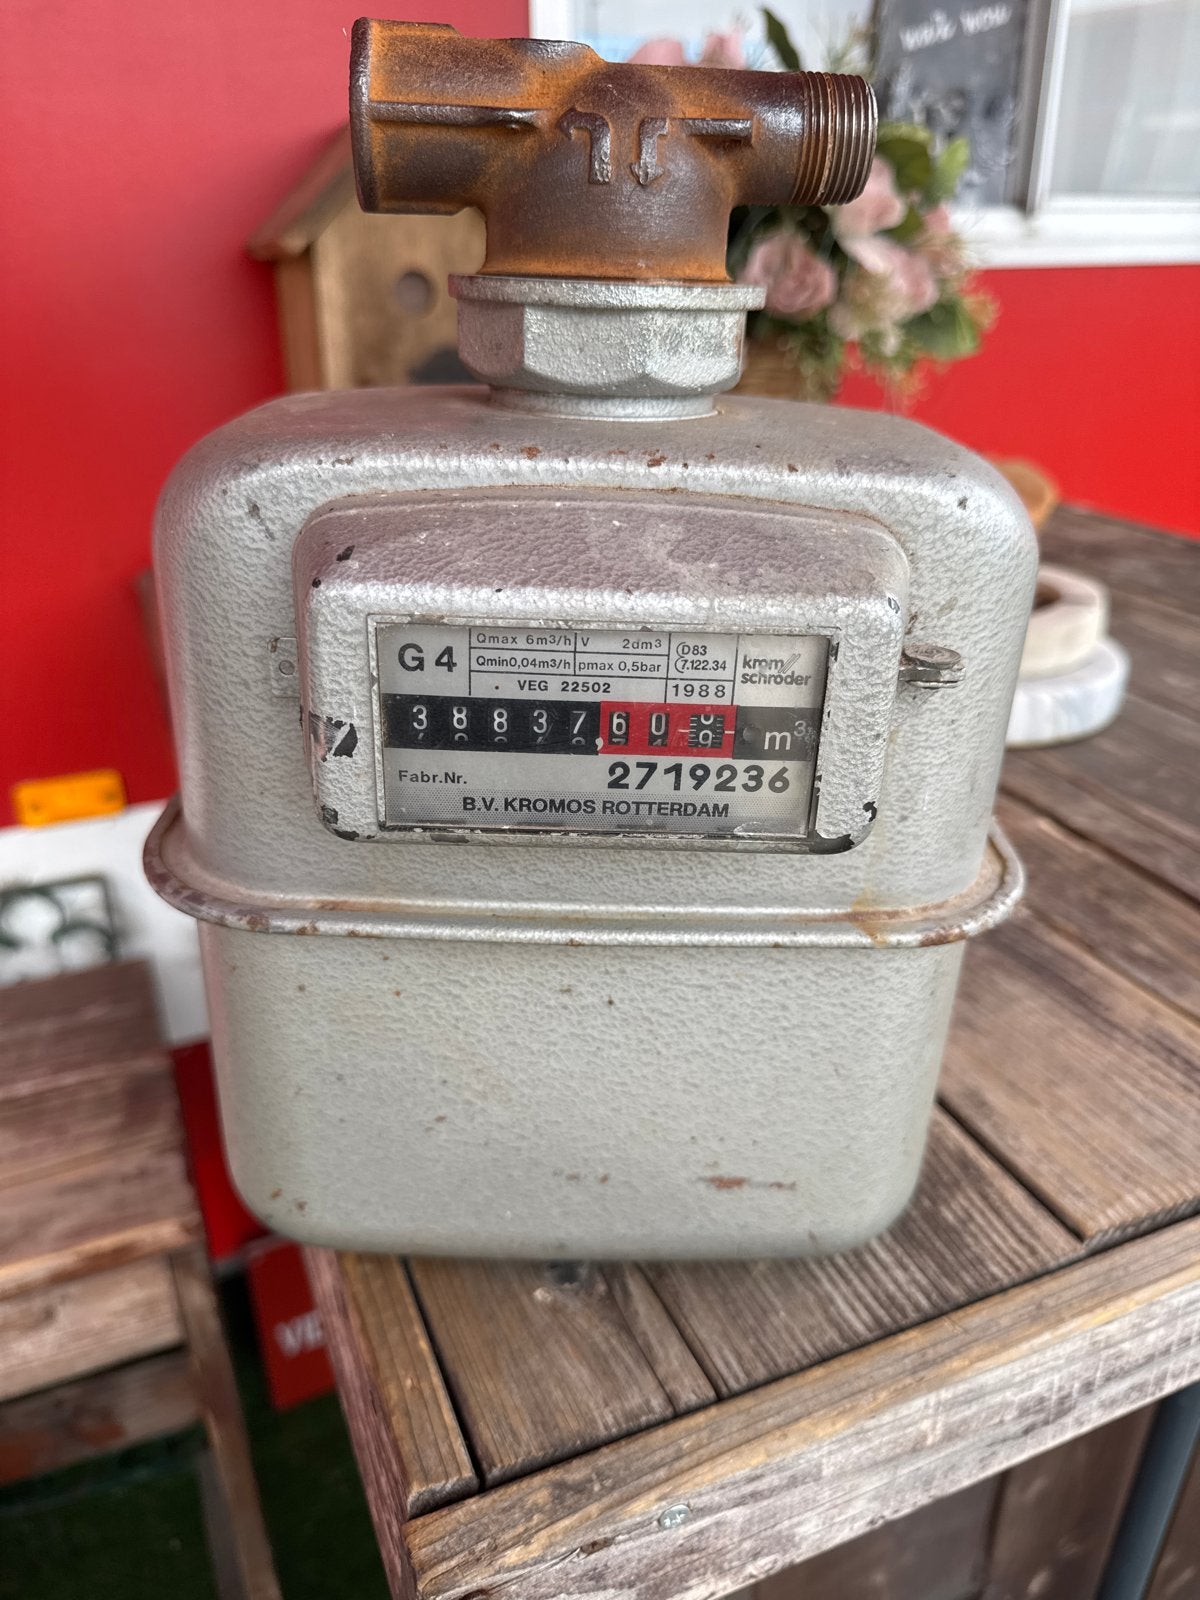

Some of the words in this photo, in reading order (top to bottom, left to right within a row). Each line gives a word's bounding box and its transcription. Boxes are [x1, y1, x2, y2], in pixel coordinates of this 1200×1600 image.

[476, 632, 518, 645] Qmax
[581, 637, 589, 647] V
[578, 661, 614, 671] pmax
[618, 660, 661, 673] 0,5bar
[517, 679, 549, 692] VEG
[560, 680, 611, 694] 22502
[671, 683, 726, 698] 1988
[398, 769, 468, 785] Fabr.Nr.
[607, 761, 790, 794] 2719236
[462, 796, 499, 812] B.V.
[503, 797, 596, 815] KROMOS
[602, 800, 729, 818] ROTTERDAM
